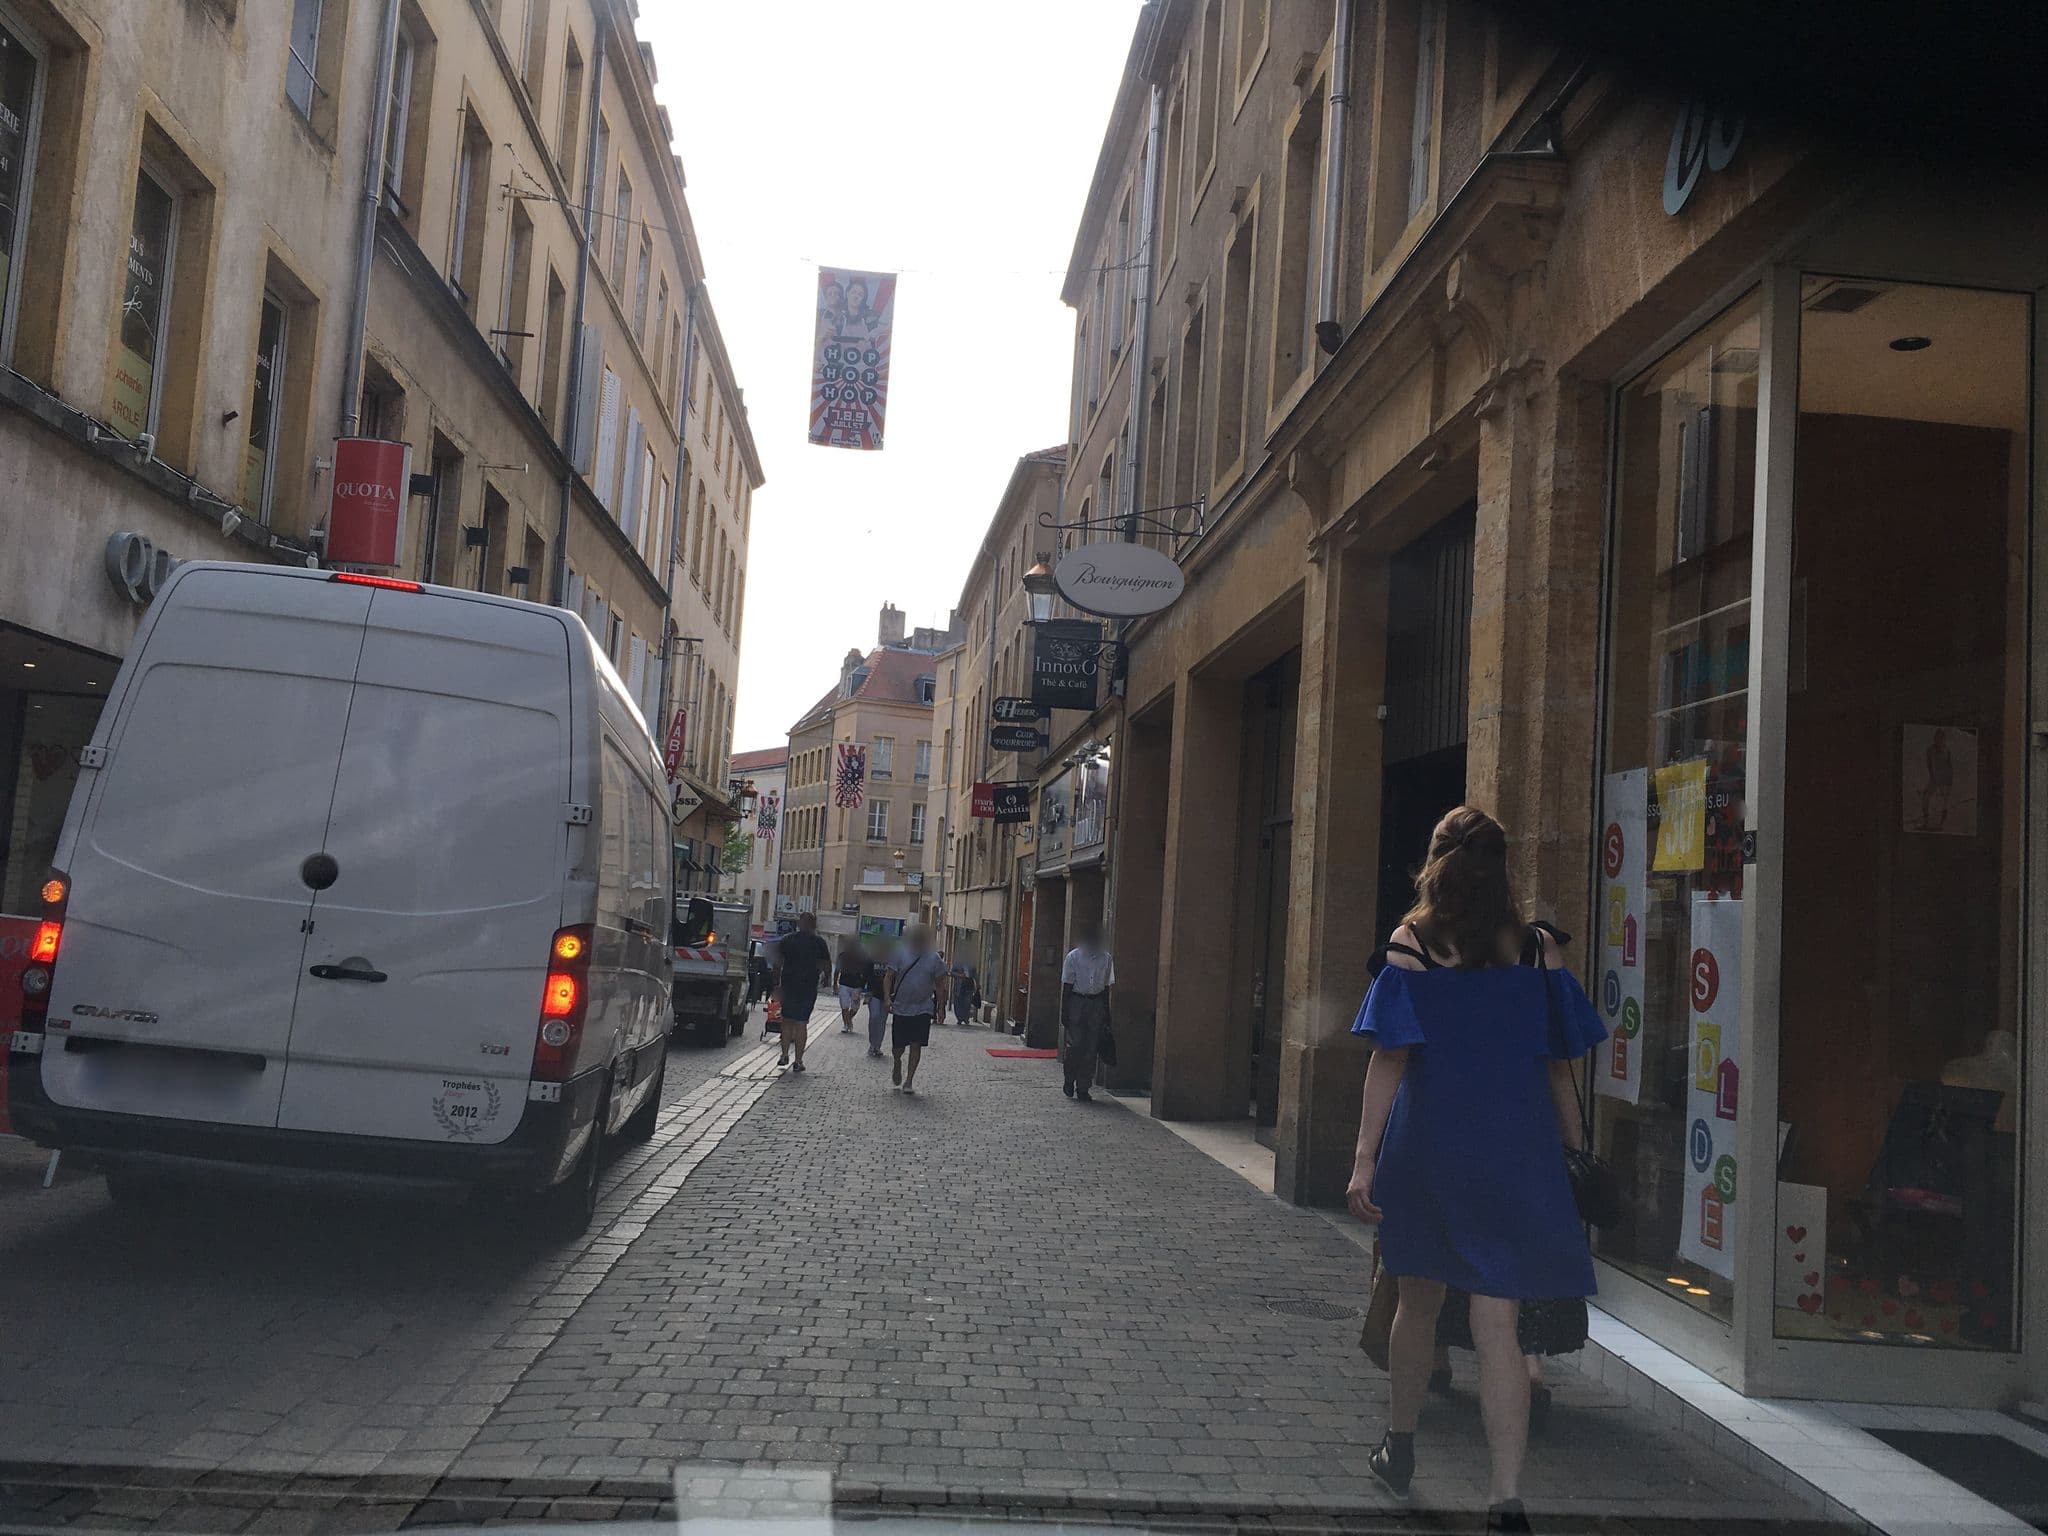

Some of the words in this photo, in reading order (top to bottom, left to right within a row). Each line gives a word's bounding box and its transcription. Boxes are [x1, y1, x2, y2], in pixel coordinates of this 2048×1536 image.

[828, 348, 877, 363] HOP
[826, 367, 875, 382] HOP
[824, 387, 873, 402] HOP
[336, 481, 396, 501] QUOTA
[1071, 562, 1175, 592] Bourguignon
[1035, 656, 1097, 676] InnovO
[1058, 679, 1066, 688] &
[666, 711, 687, 781] TABAC
[72, 1004, 160, 1024] CRAFTER
[481, 1043, 510, 1056] TDI
[442, 1080, 481, 1093] Trophées
[450, 1104, 478, 1119] 2012
